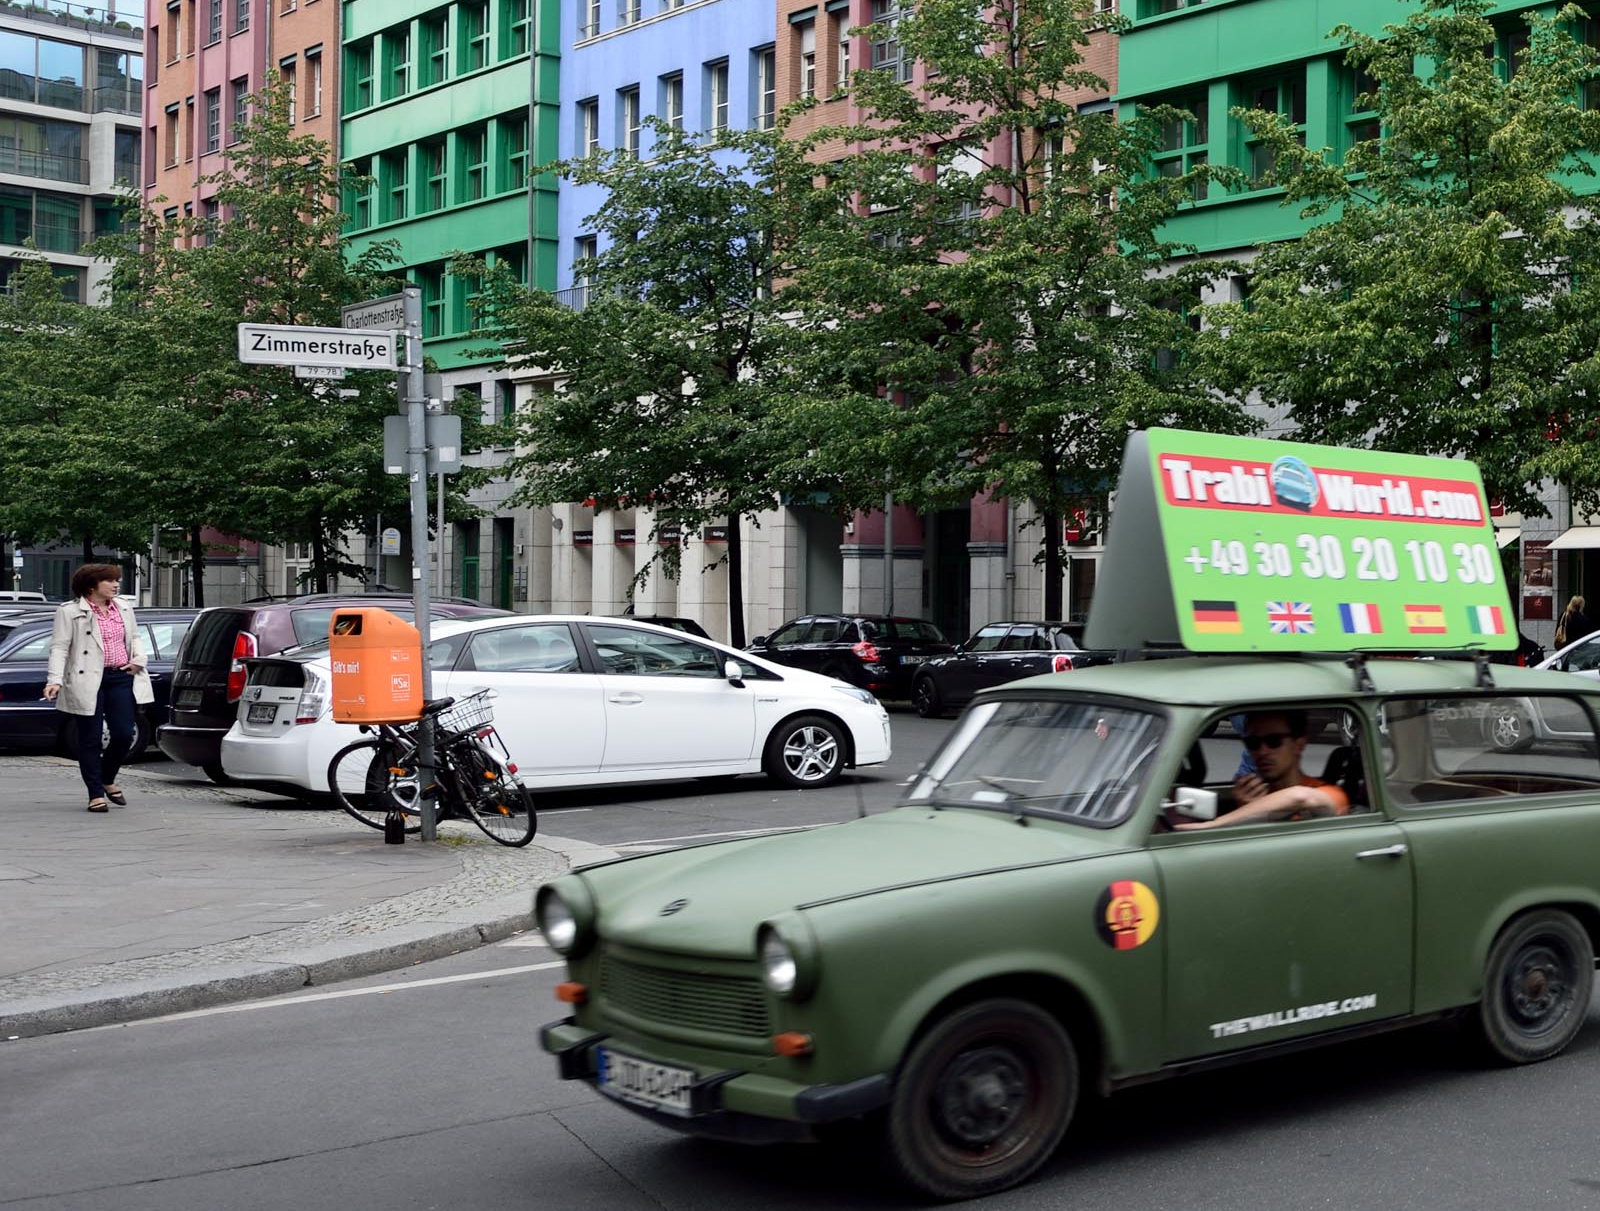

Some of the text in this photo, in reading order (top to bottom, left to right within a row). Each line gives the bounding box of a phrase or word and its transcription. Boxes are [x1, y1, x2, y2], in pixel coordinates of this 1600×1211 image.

[251, 333, 387, 360] Zimmerstraße
[1162, 458, 1483, 522] Trabi World.com
[1184, 534, 1496, 585] +49 30 30 20 10 30
[1209, 993, 1378, 1039] THEWALLRIDE.COM
